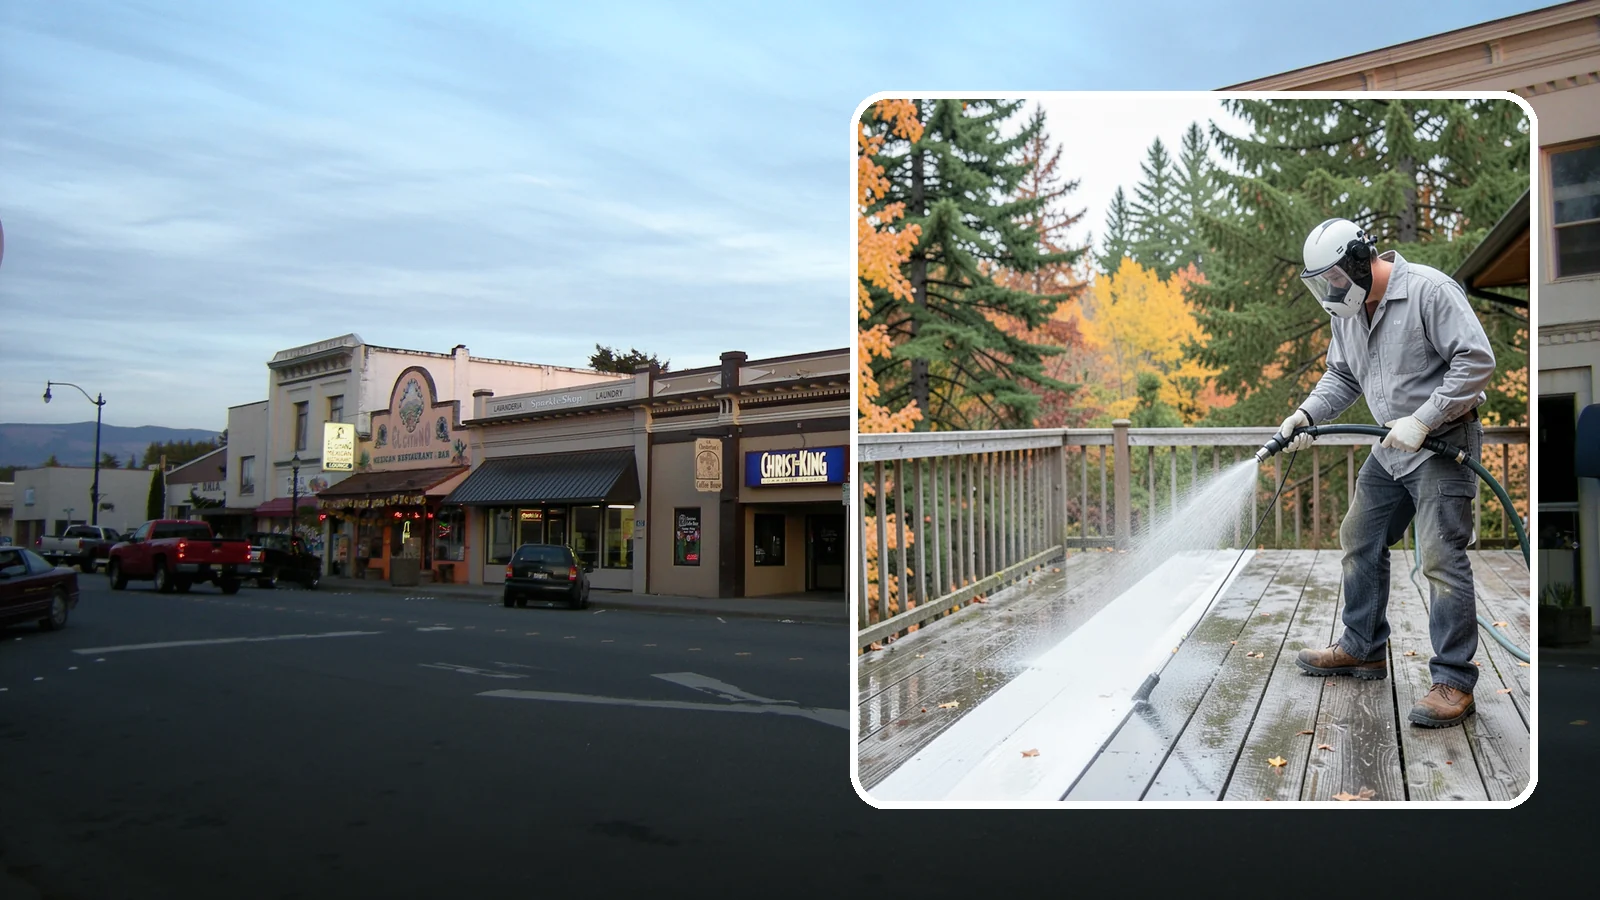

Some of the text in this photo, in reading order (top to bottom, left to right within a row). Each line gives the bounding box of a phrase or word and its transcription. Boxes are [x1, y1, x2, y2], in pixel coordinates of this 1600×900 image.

[595, 389, 624, 399] LAUNDRY
[494, 402, 522, 412] LAVANDERIA
[531, 395, 582, 409] Sparkle Shop
[374, 454, 396, 463] MEXICAN
[397, 451, 433, 462] RESTAURANT
[438, 450, 450, 459] BAR
